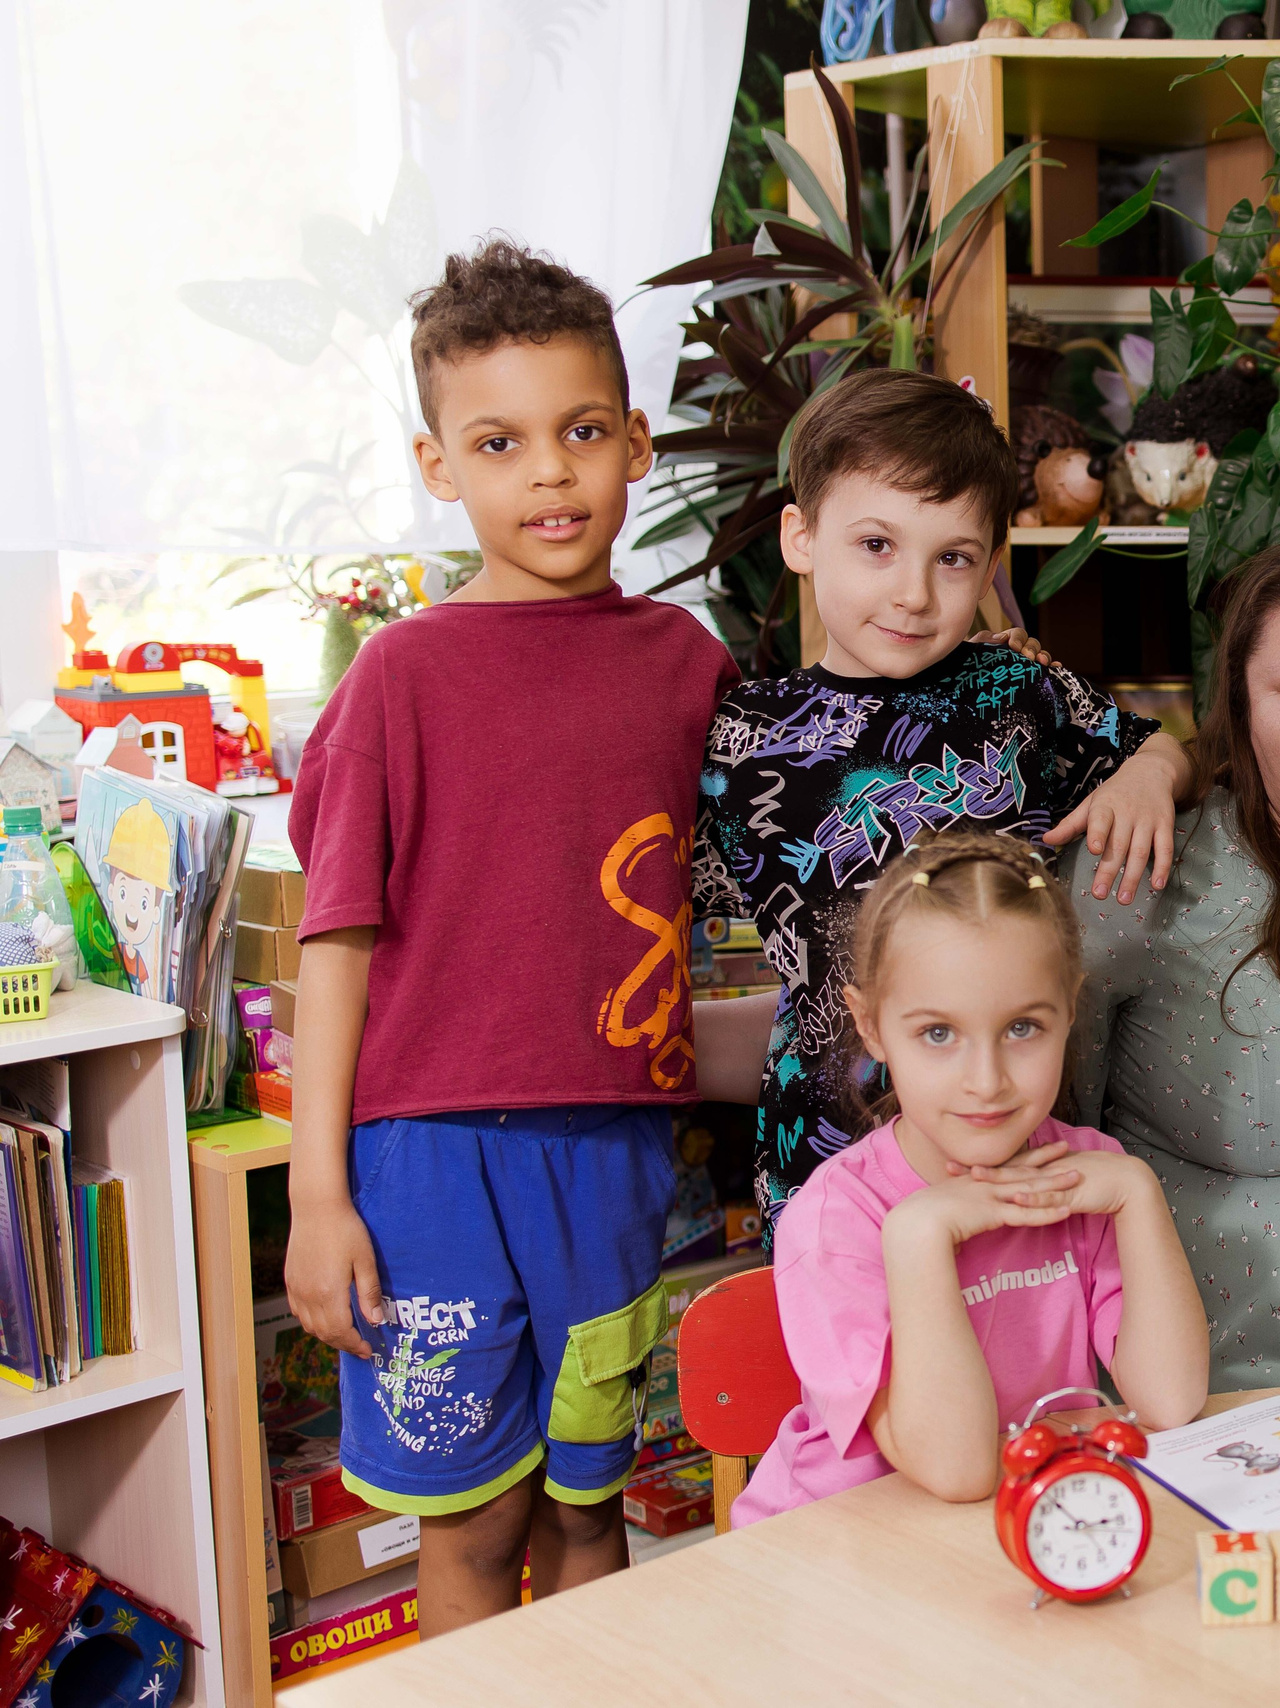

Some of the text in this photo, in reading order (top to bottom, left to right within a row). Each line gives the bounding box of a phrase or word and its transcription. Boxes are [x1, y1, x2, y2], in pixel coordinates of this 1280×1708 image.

[976, 685, 1020, 712] ART
[813, 725, 1032, 890] STREET
[428, 1328, 470, 1346] CRRN
[371, 1353, 457, 1384] TO CHANGE
[392, 1345, 426, 1366] HAS
[378, 1370, 445, 1397] FOR YOU
[392, 1394, 426, 1410] AND
[373, 1389, 427, 1453] STARTING
[1070, 1478, 1086, 1491] 12
[1076, 1556, 1087, 1571] 6
[289, 1597, 419, 1663] ОВОЩИ И
